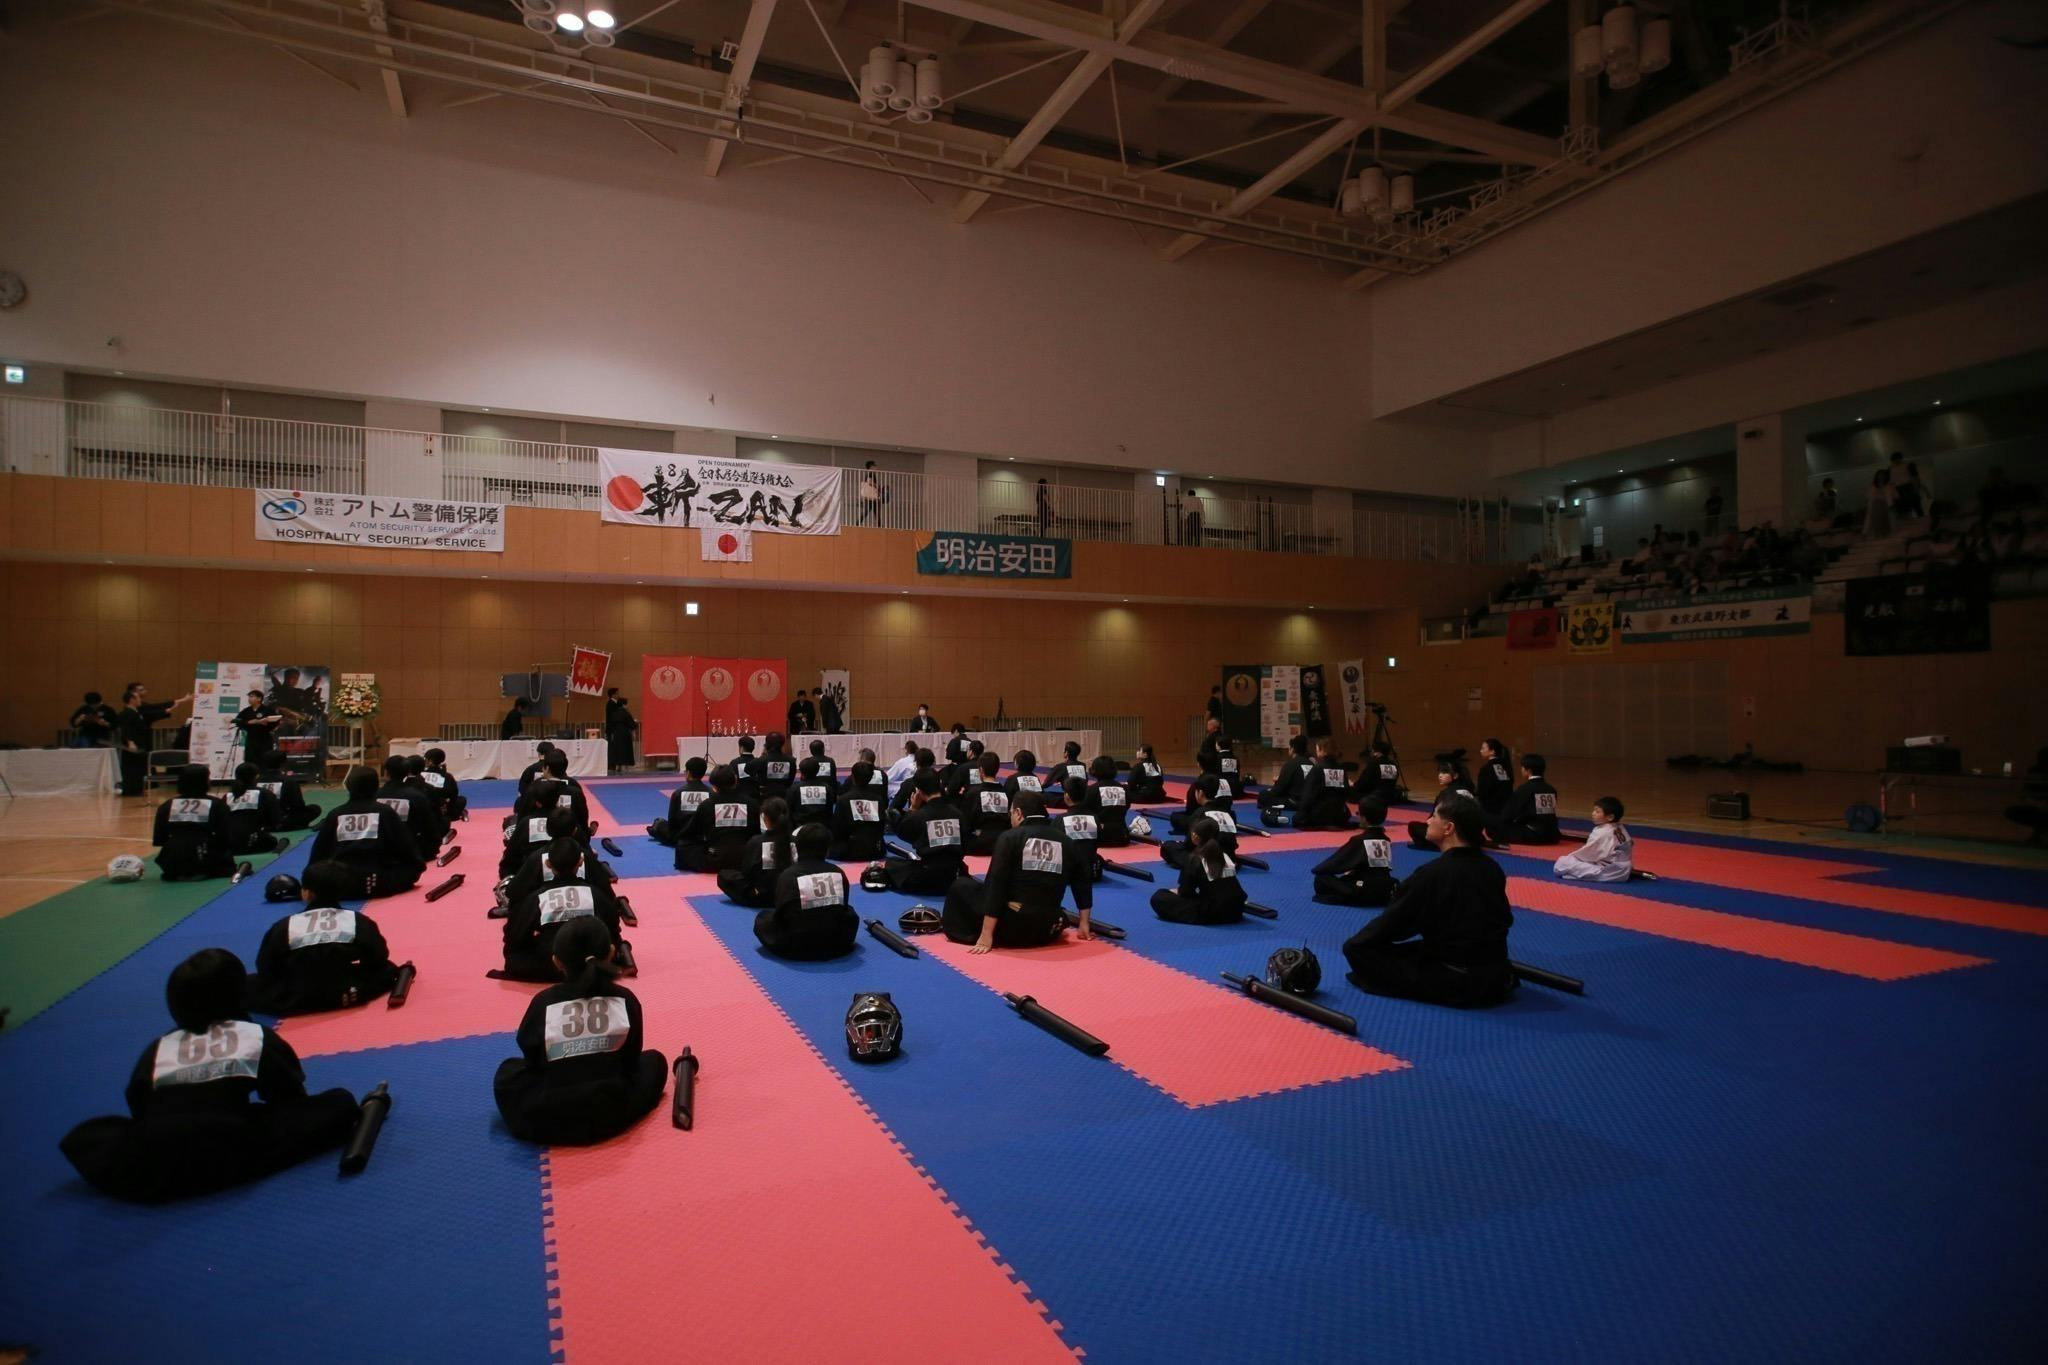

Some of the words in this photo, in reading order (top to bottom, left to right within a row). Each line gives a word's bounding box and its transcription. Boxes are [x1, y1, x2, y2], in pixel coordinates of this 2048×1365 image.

[713, 460, 750, 469] TOURNAMENT
[342, 498, 499, 525] アトム警備保障
[276, 528, 360, 542] HOSPITALITY
[368, 534, 429, 546] SECURITY
[436, 537, 487, 548] SERVICE
[350, 521, 377, 530] ATOM
[380, 523, 426, 533] SECURITY
[427, 526, 465, 535] SERVICE
[936, 538, 1057, 574] 明治安田
[772, 762, 785, 774] 62
[806, 787, 820, 799] 68
[180, 800, 200, 815] 22
[345, 815, 368, 832] 30
[934, 821, 954, 838] 56
[1032, 840, 1054, 861] 49
[812, 876, 837, 898] 51
[550, 887, 580, 909] 59
[304, 909, 337, 933] 73
[562, 999, 609, 1038] 38
[177, 1020, 239, 1065] 65
